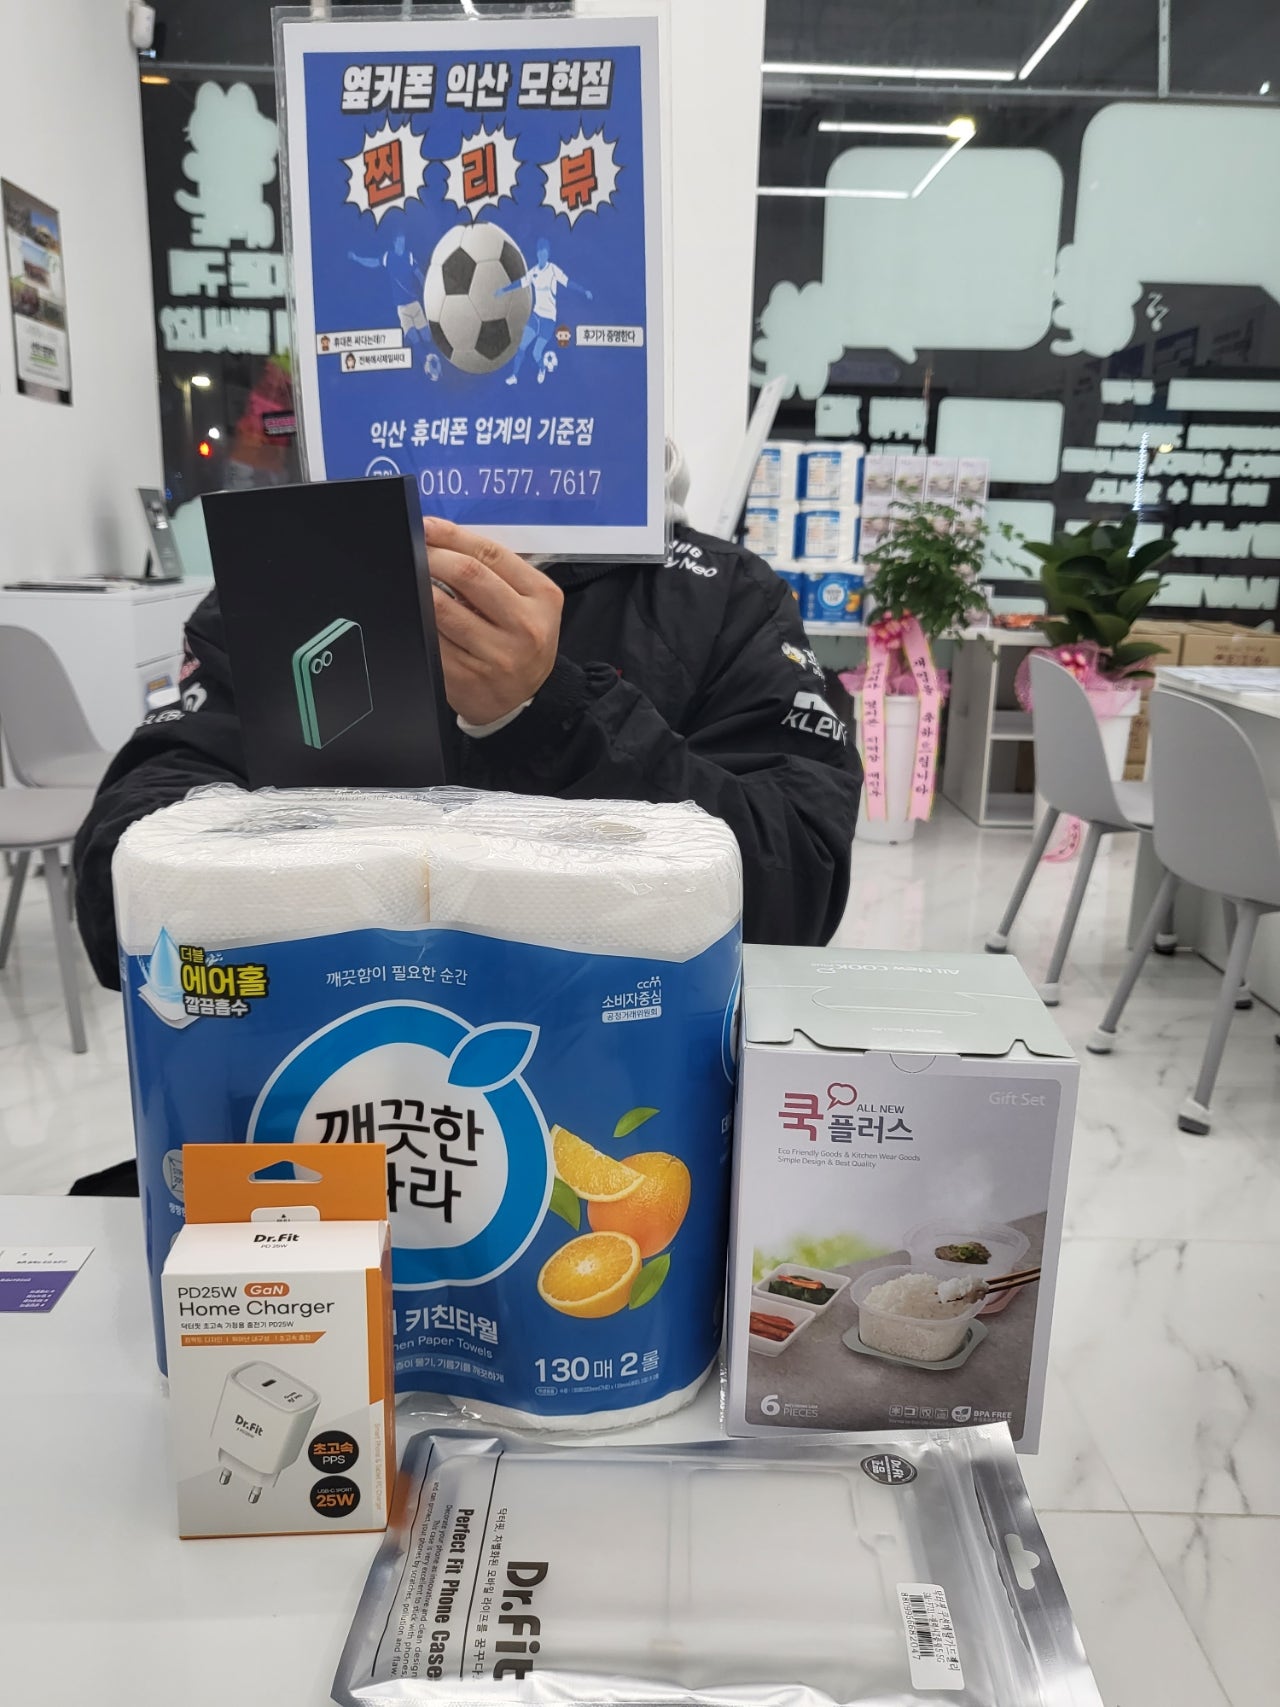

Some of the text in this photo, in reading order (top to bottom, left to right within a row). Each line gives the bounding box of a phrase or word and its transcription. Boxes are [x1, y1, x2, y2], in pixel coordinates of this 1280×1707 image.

[341, 59, 613, 113] 옆커폰 익산 모현점
[363, 138, 598, 211] 찐 리 뷰
[334, 336, 353, 348] 휴대폰
[583, 329, 605, 343] 후기가
[370, 416, 595, 449] 익산 휴대폰 업계의 기준점
[420, 468, 601, 496] 010. 7577. 7617
[180, 946, 205, 963] 더블
[181, 963, 268, 997] 에어홀
[326, 965, 468, 987] 깨끗함이 필요한 순간
[183, 995, 250, 1018] 깔끔흡수
[601, 989, 662, 1009] 소비자중심
[606, 1007, 658, 1021] 공정거래위원회
[856, 1103, 905, 1114] ALL NEW
[988, 1091, 1046, 1107] Gift Set
[778, 1092, 824, 1141] 쿡
[827, 1114, 914, 1144] 플러스
[315, 1099, 485, 1168] 깨끗한
[778, 1147, 791, 1155] Eco
[792, 1148, 819, 1158] Friendly
[820, 1150, 842, 1158] Goods
[851, 1151, 878, 1160] Kitchen
[898, 1153, 920, 1161] Goods
[778, 1155, 800, 1164] Simple
[801, 1157, 825, 1167] Design
[835, 1159, 850, 1167] Best
[851, 1160, 877, 1168] Quality
[253, 1233, 300, 1243] Dr.Fit
[178, 1285, 285, 1299] PD25W GaN
[179, 1299, 335, 1318] Home Charger
[203, 1322, 223, 1330] 초고속
[225, 1321, 245, 1329] 가정용
[247, 1321, 267, 1329] 충전기
[405, 1304, 499, 1345] 키친타월
[418, 1335, 455, 1347] Paper
[456, 1337, 493, 1359] Towels
[472, 1366, 505, 1384] 깨끗하게
[760, 1394, 781, 1417] 6
[783, 1407, 819, 1418] PIECES
[973, 1410, 1012, 1420] BPA FREE
[234, 1413, 264, 1437] Dr.Fit
[313, 1442, 353, 1456] 초고속
[322, 1455, 346, 1465] PPS
[316, 1494, 354, 1508] 25W
[441, 1504, 453, 1529] Decorate
[420, 1523, 428, 1536] your
[428, 1531, 437, 1544] case
[438, 1530, 446, 1544] your
[415, 1537, 425, 1560] phones
[434, 1545, 444, 1564] phone
[488, 1534, 504, 1566] 차별화된
[411, 1560, 420, 1569] by
[422, 1552, 430, 1566] very
[416, 1567, 428, 1595] excellent
[423, 1573, 437, 1607] innovative
[483, 1570, 497, 1594] 모바일
[426, 1508, 475, 1679] Perfect Fit Phone Case
[397, 1603, 410, 1636] pollution
[410, 1606, 420, 1622] stick
[420, 1609, 428, 1622] and
[476, 1597, 492, 1632] 라이프를
[492, 1561, 549, 1681] Dr.Fit
[407, 1624, 416, 1640] with
[415, 1624, 425, 1644] clean
[394, 1638, 402, 1653] and
[410, 1647, 422, 1678] design
